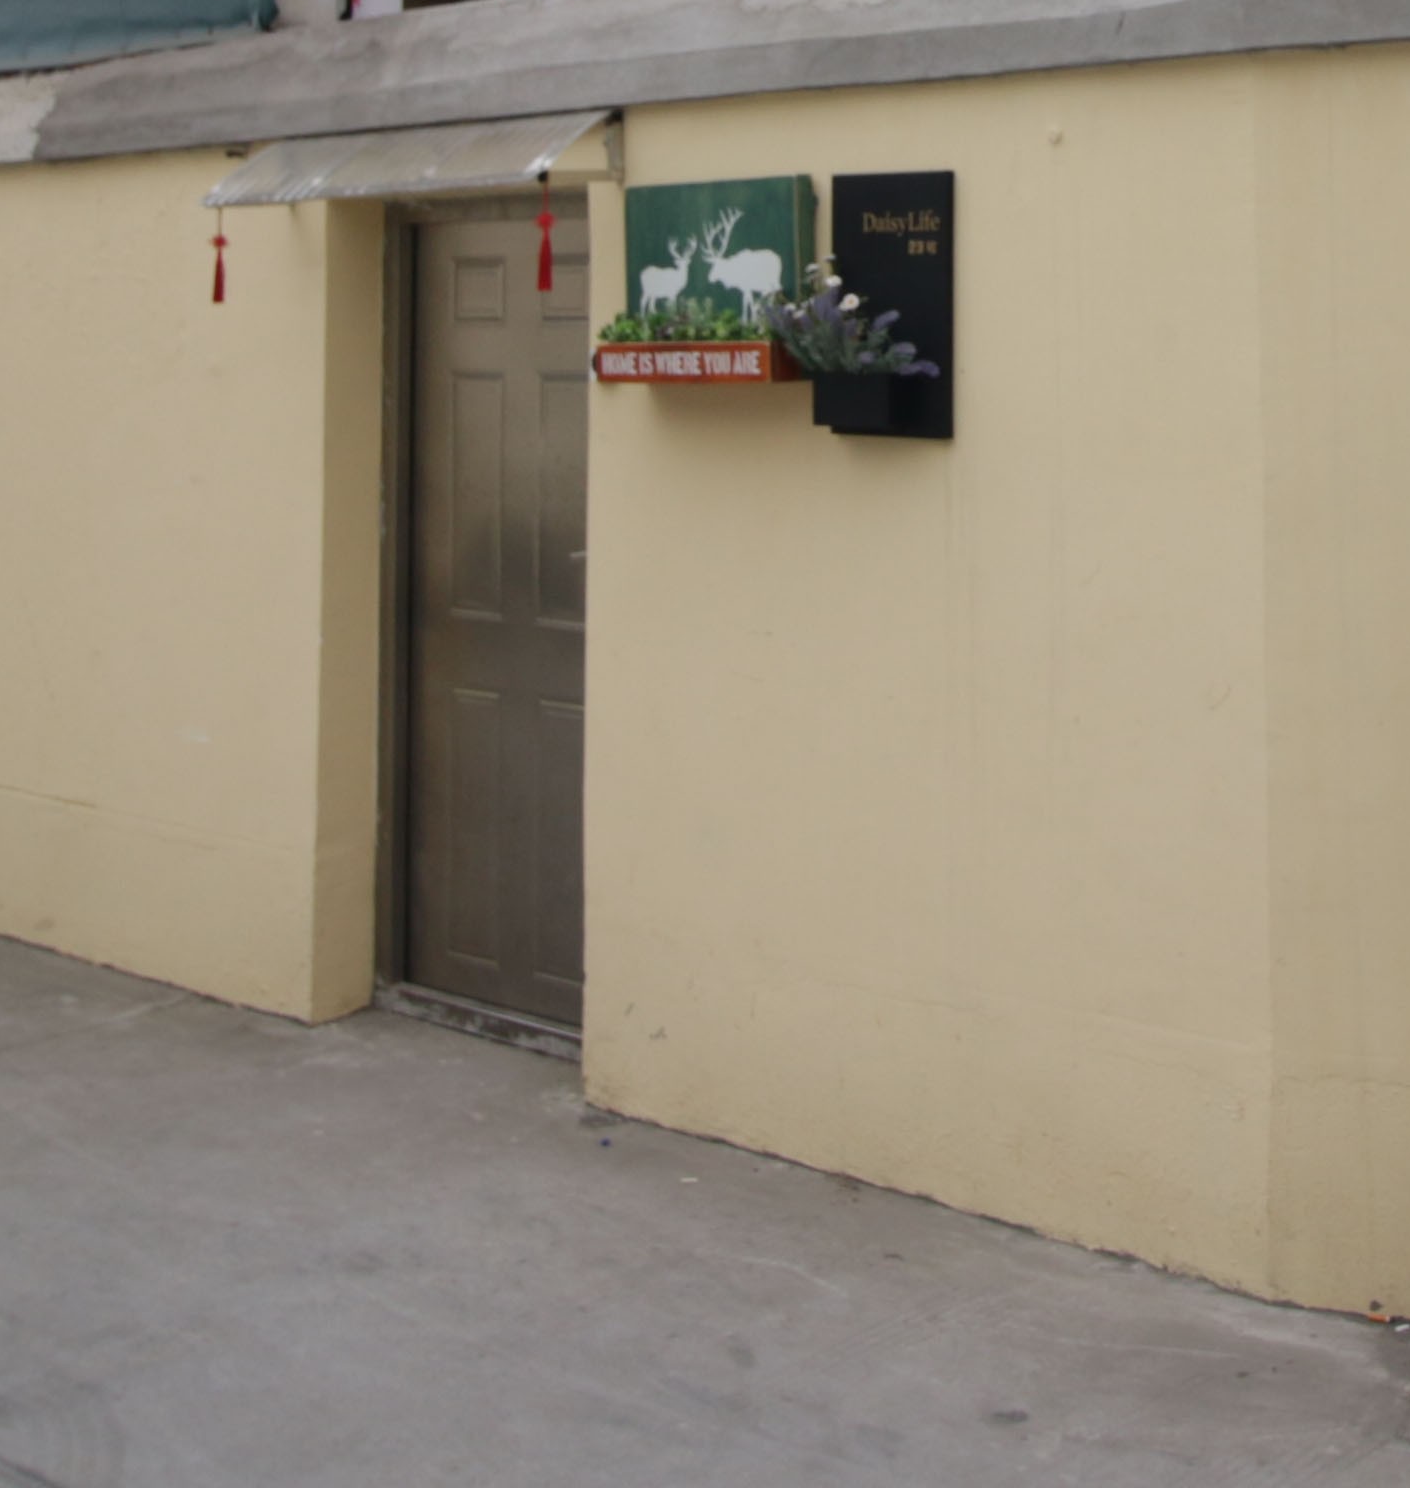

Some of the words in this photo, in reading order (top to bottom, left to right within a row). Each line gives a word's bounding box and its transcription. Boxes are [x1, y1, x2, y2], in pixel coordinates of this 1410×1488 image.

[601, 352, 637, 375] HOME
[639, 352, 653, 375] IS
[654, 352, 701, 375] WHERE
[703, 352, 731, 374] YOU
[732, 351, 761, 374] ARE
